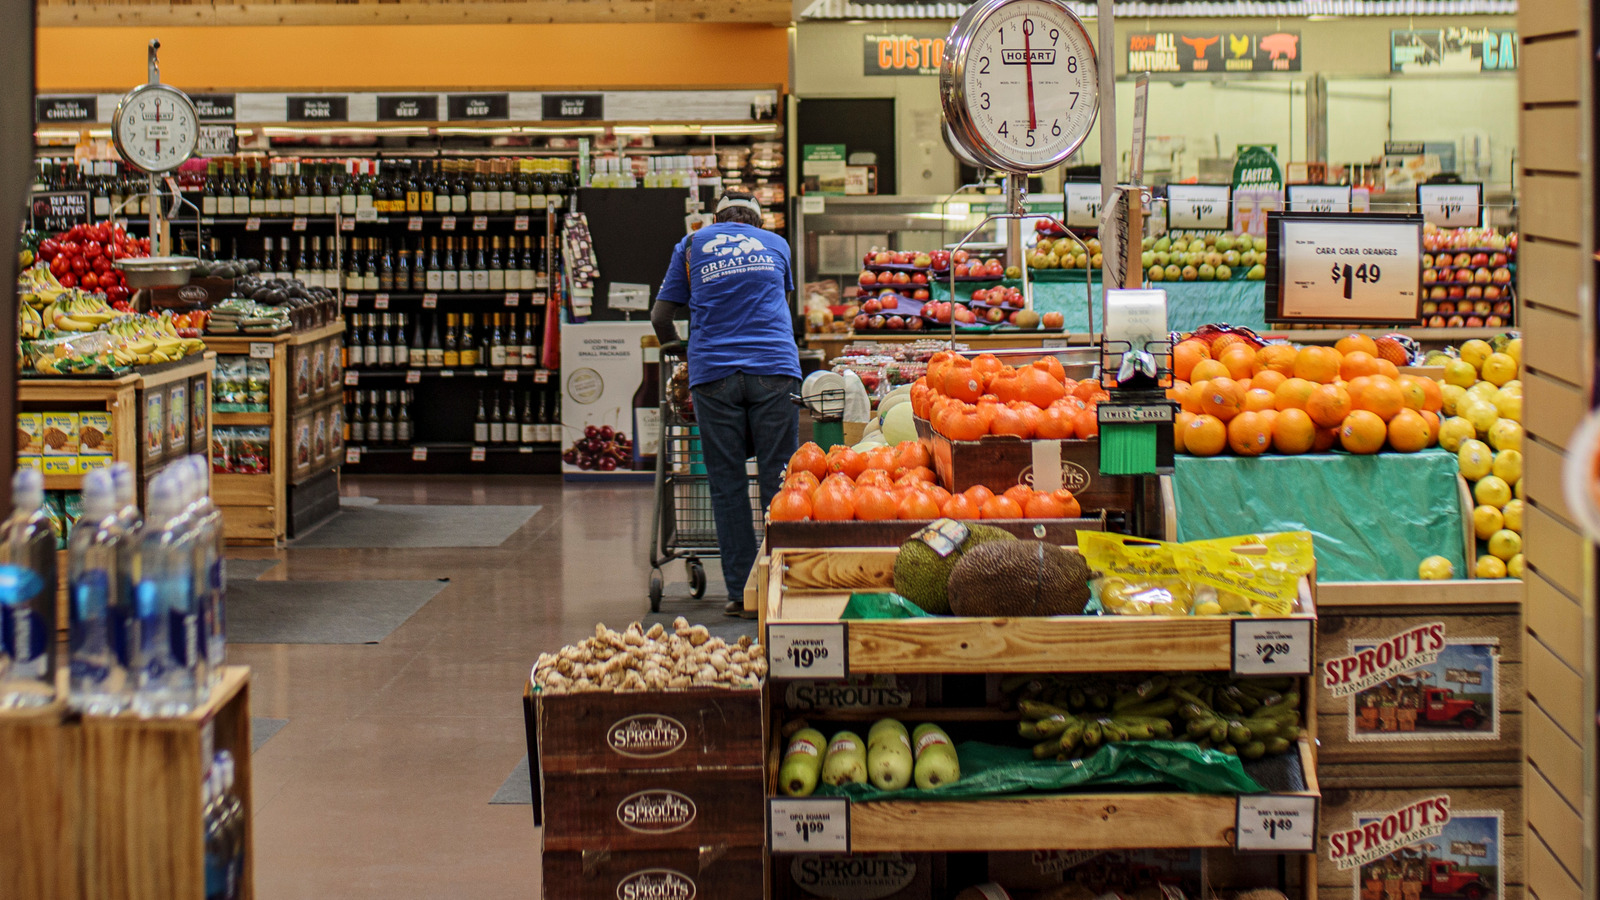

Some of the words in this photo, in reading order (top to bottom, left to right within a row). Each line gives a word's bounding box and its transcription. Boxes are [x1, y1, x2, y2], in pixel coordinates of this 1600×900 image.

[998, 27, 1004, 45] 1
[1049, 29, 1059, 47] 9
[1155, 33, 1177, 52] ALL
[879, 39, 945, 69] CUSTO
[1007, 52, 1051, 60] HOBART
[1129, 51, 1181, 71] NATURAL
[979, 56, 990, 74] 2
[1067, 56, 1077, 73] 8
[1272, 59, 1290, 70] PORK
[980, 92, 990, 110] 3
[1069, 91, 1079, 110] 7
[47, 108, 88, 119] CHICKEN
[197, 106, 226, 116] ICKEN
[304, 108, 330, 117] PORK
[396, 108, 419, 117] BEEF
[466, 106, 490, 115] BEEF
[561, 106, 584, 115] BEEF
[997, 120, 1008, 138] 4
[1051, 119, 1061, 137] 6
[1025, 129, 1035, 147] 5
[1241, 167, 1273, 182] EASTER
[52, 206, 86, 216] PEPPERS
[1087, 202, 1102, 219] $19
[1316, 247, 1336, 255] CARA
[1339, 247, 1360, 255] CARA
[1362, 248, 1398, 256] ORANGES
[701, 257, 744, 275] GREAT
[748, 255, 774, 264] OAK
[721, 267, 746, 277] ASSISTED
[1326, 625, 1443, 686] SPROUTS
[1334, 671, 1386, 696] FARMERS
[1389, 652, 1436, 674] MARKET
[796, 686, 903, 710] SPROUTS
[614, 728, 679, 747] SPROUTS
[624, 804, 689, 823] SPROUTS
[1331, 797, 1448, 858] SPROUTS
[1340, 843, 1391, 868] FARMERS
[1394, 826, 1440, 846] MARKET
[801, 859, 907, 885] SPROUTS
[624, 883, 689, 900] SPROUTS
